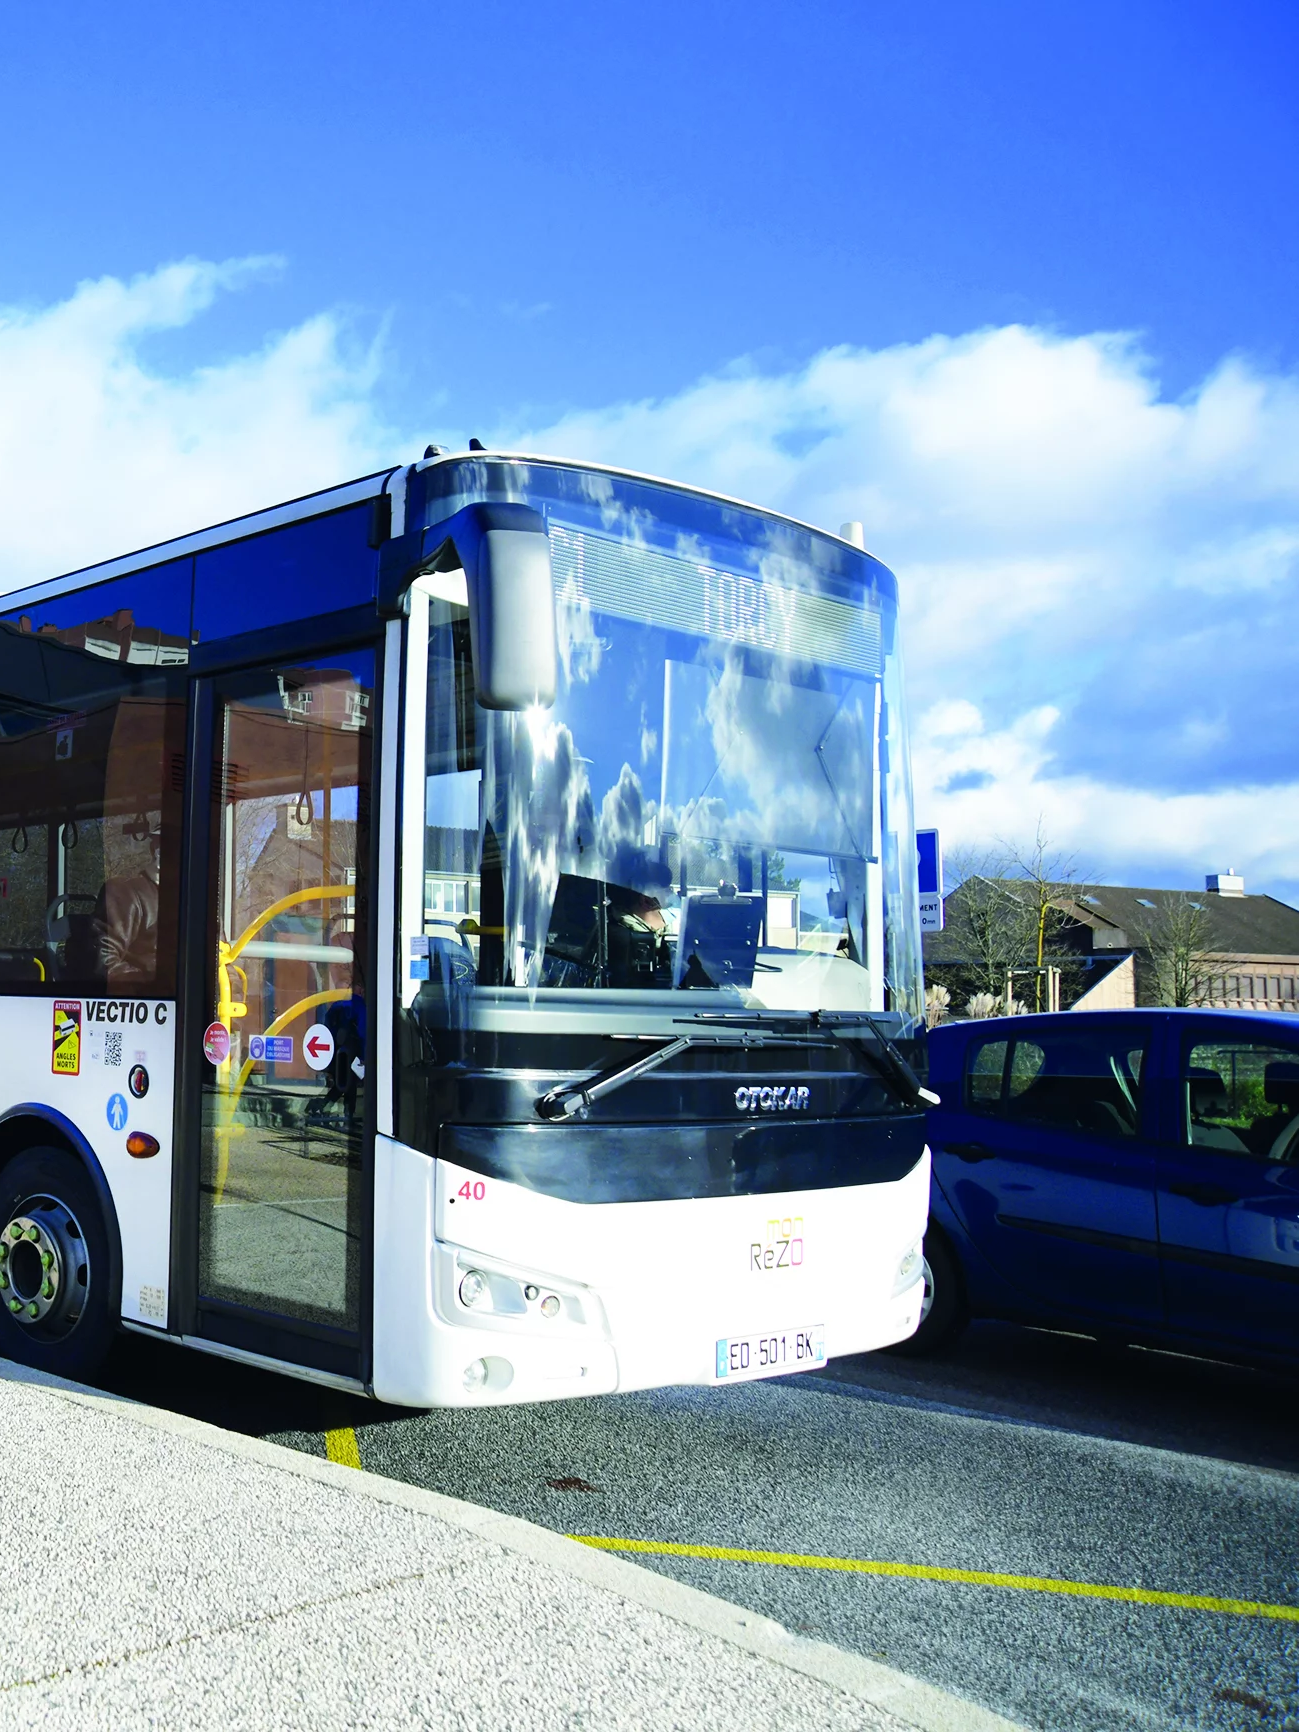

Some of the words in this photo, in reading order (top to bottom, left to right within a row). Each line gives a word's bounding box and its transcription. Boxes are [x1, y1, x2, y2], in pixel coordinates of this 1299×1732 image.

[697, 564, 798, 653] TORCY
[55, 1001, 81, 1011] ATTENTION
[85, 1000, 149, 1025] VECTIO
[154, 1002, 168, 1026] C
[56, 1052, 77, 1061] ANGLES
[56, 1060, 75, 1069] MORTS
[735, 1086, 810, 1111] OTOKAR
[458, 1180, 486, 1201] 40
[767, 1217, 804, 1241] mon
[750, 1238, 804, 1272] RéZO
